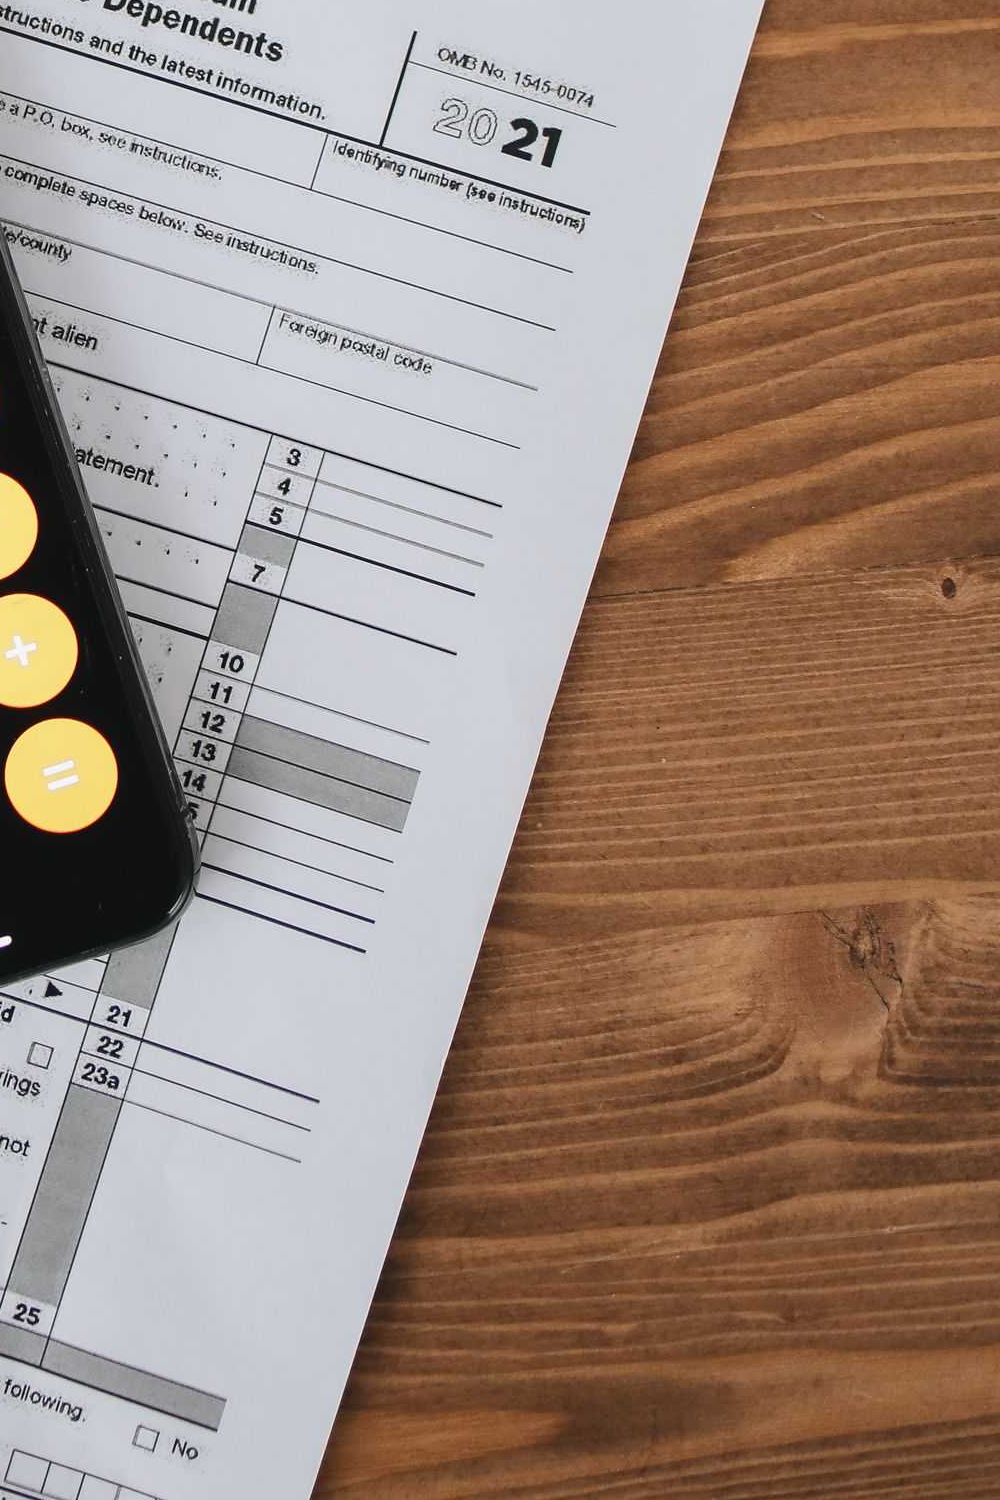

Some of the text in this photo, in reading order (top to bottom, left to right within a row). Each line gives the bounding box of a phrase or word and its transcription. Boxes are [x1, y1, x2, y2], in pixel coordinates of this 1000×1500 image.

[89, 35, 125, 57] and
[127, 44, 158, 67] the
[160, 54, 214, 85] latest
[215, 71, 325, 121] information.
[437, 47, 595, 109] OMB No. 1545-0074
[332, 140, 586, 235] Identifying number (see instructions)
[278, 312, 433, 375] Foreign postal code
[105, 1004, 132, 1028] 21
[96, 1035, 125, 1060] 22
[80, 1062, 120, 1091] 23a
[12, 1302, 41, 1327] 25
[3, 1378, 86, 1423] following.
[171, 1437, 199, 1461] No
